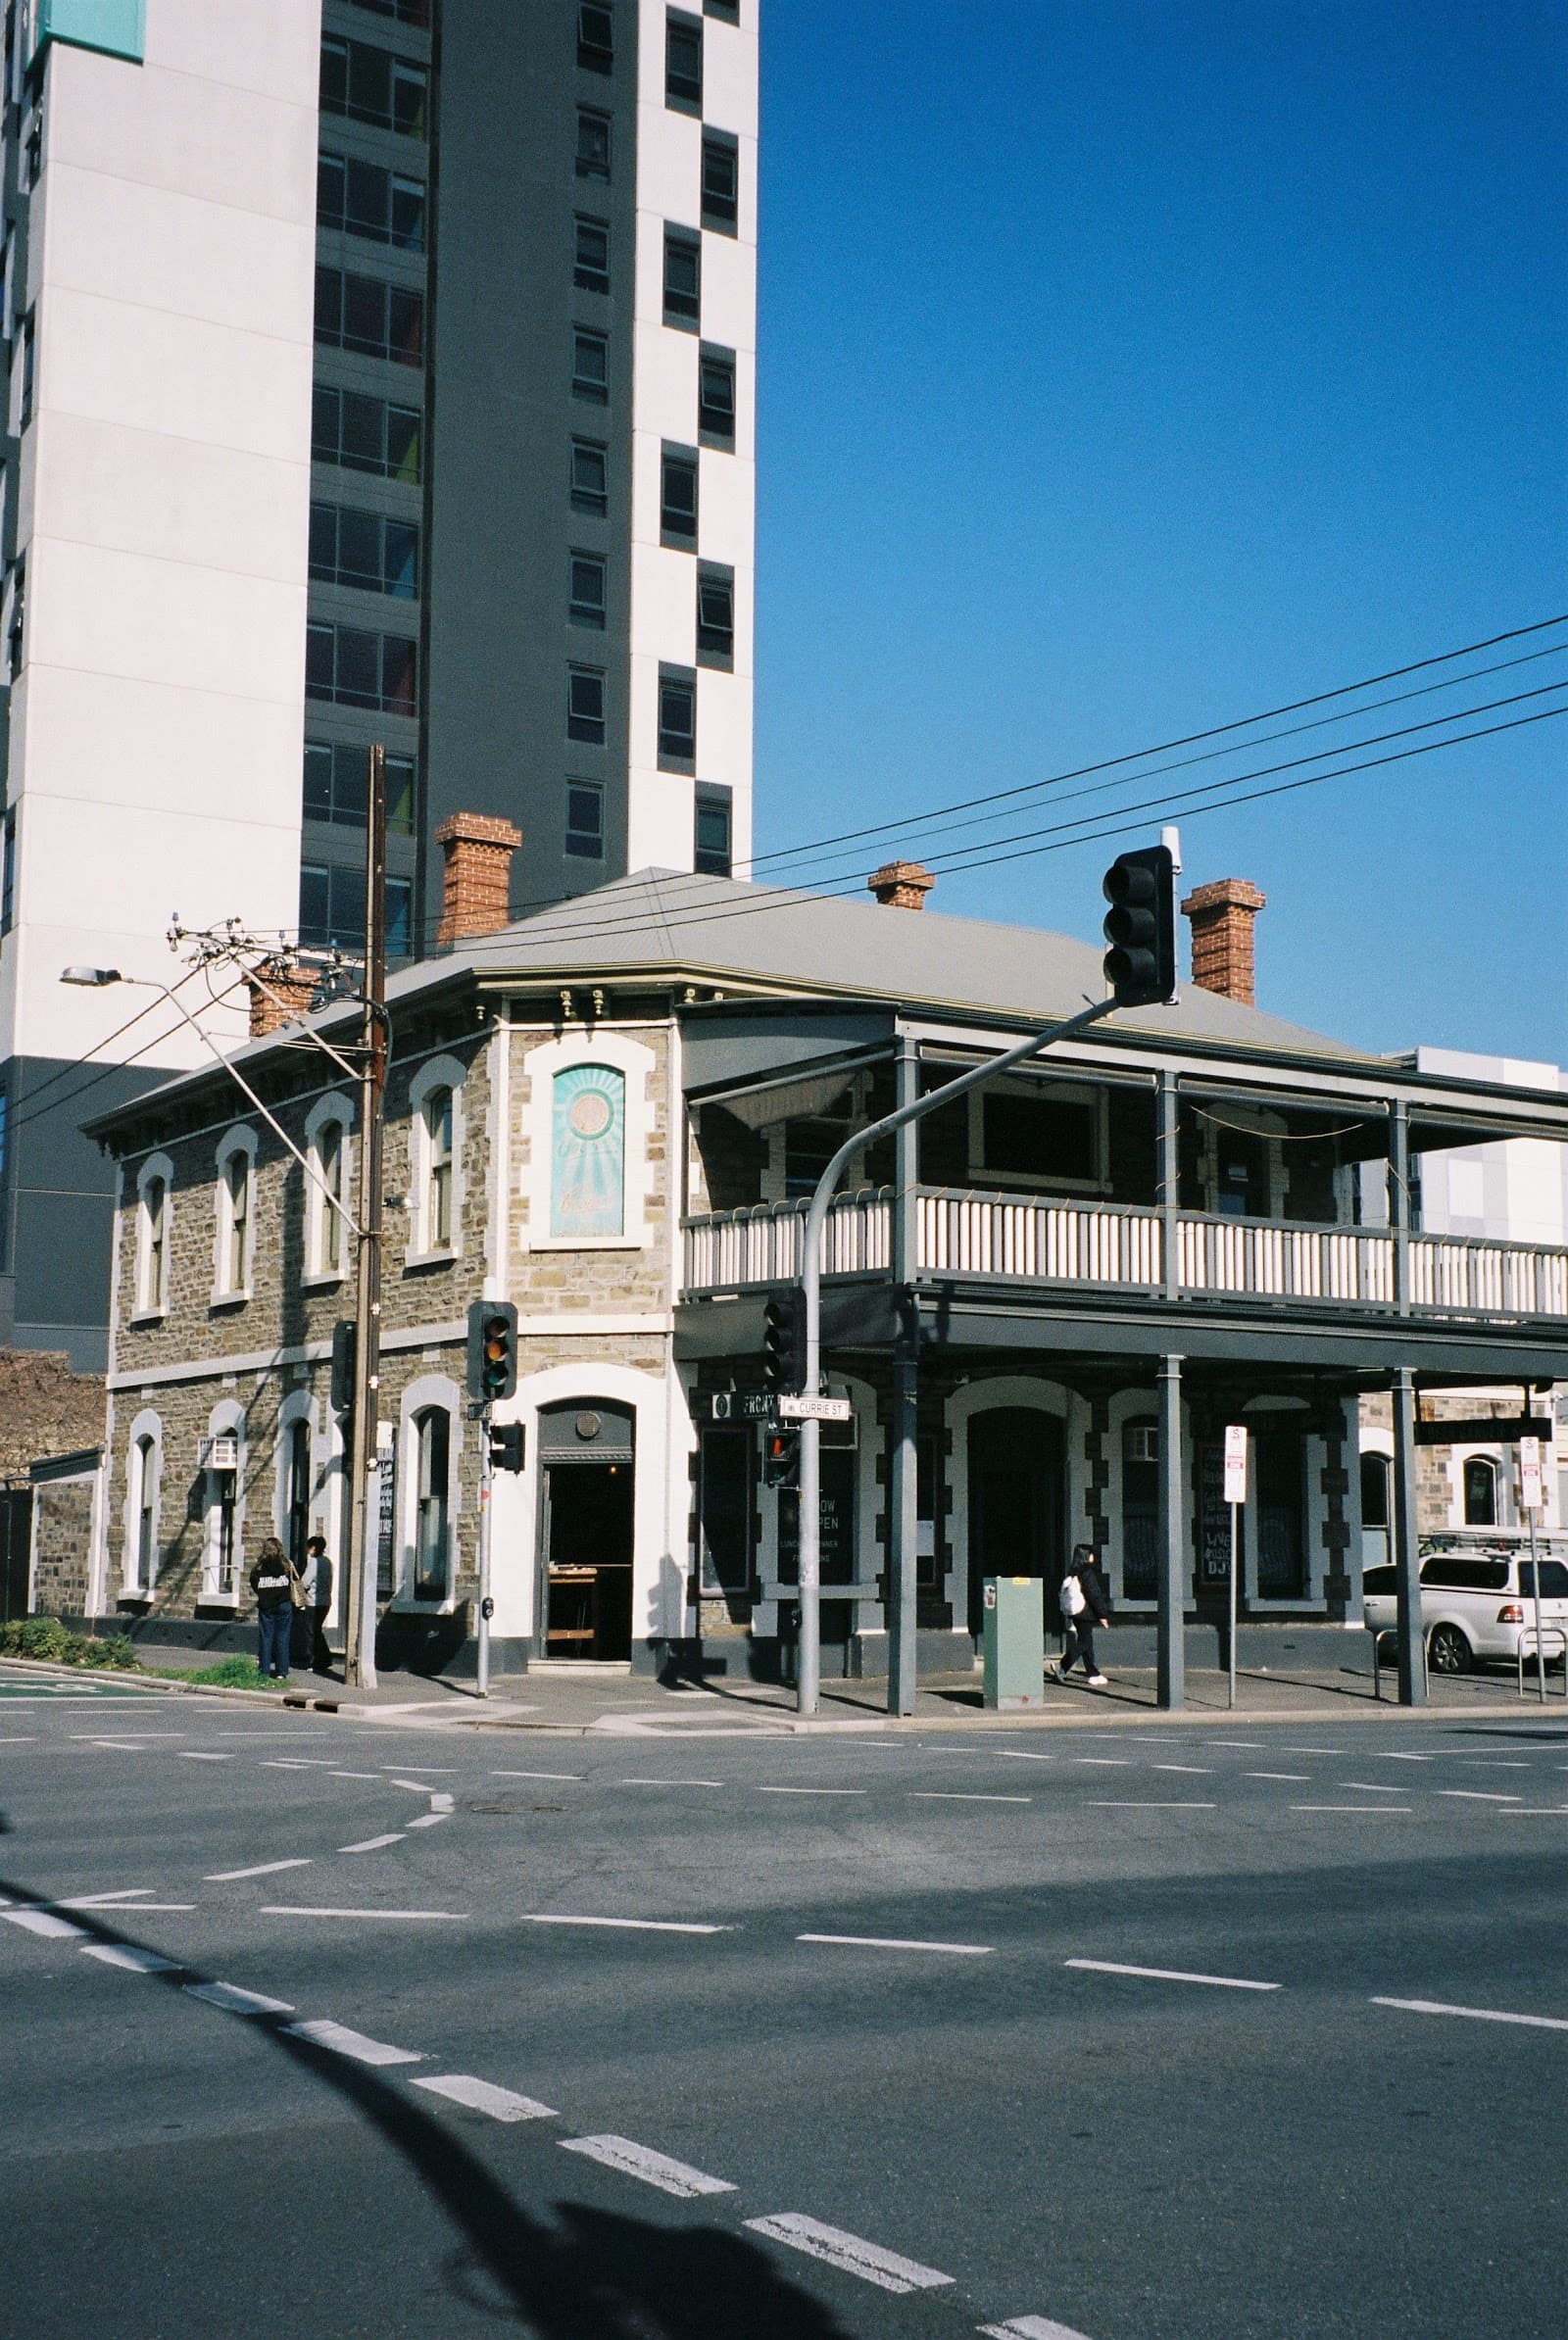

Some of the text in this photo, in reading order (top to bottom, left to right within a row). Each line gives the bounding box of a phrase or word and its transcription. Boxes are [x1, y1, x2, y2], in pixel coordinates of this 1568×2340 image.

[799, 1401, 842, 1415] CURRIE ST
[819, 1499, 836, 1513] OW
[819, 1516, 839, 1530] PEN
